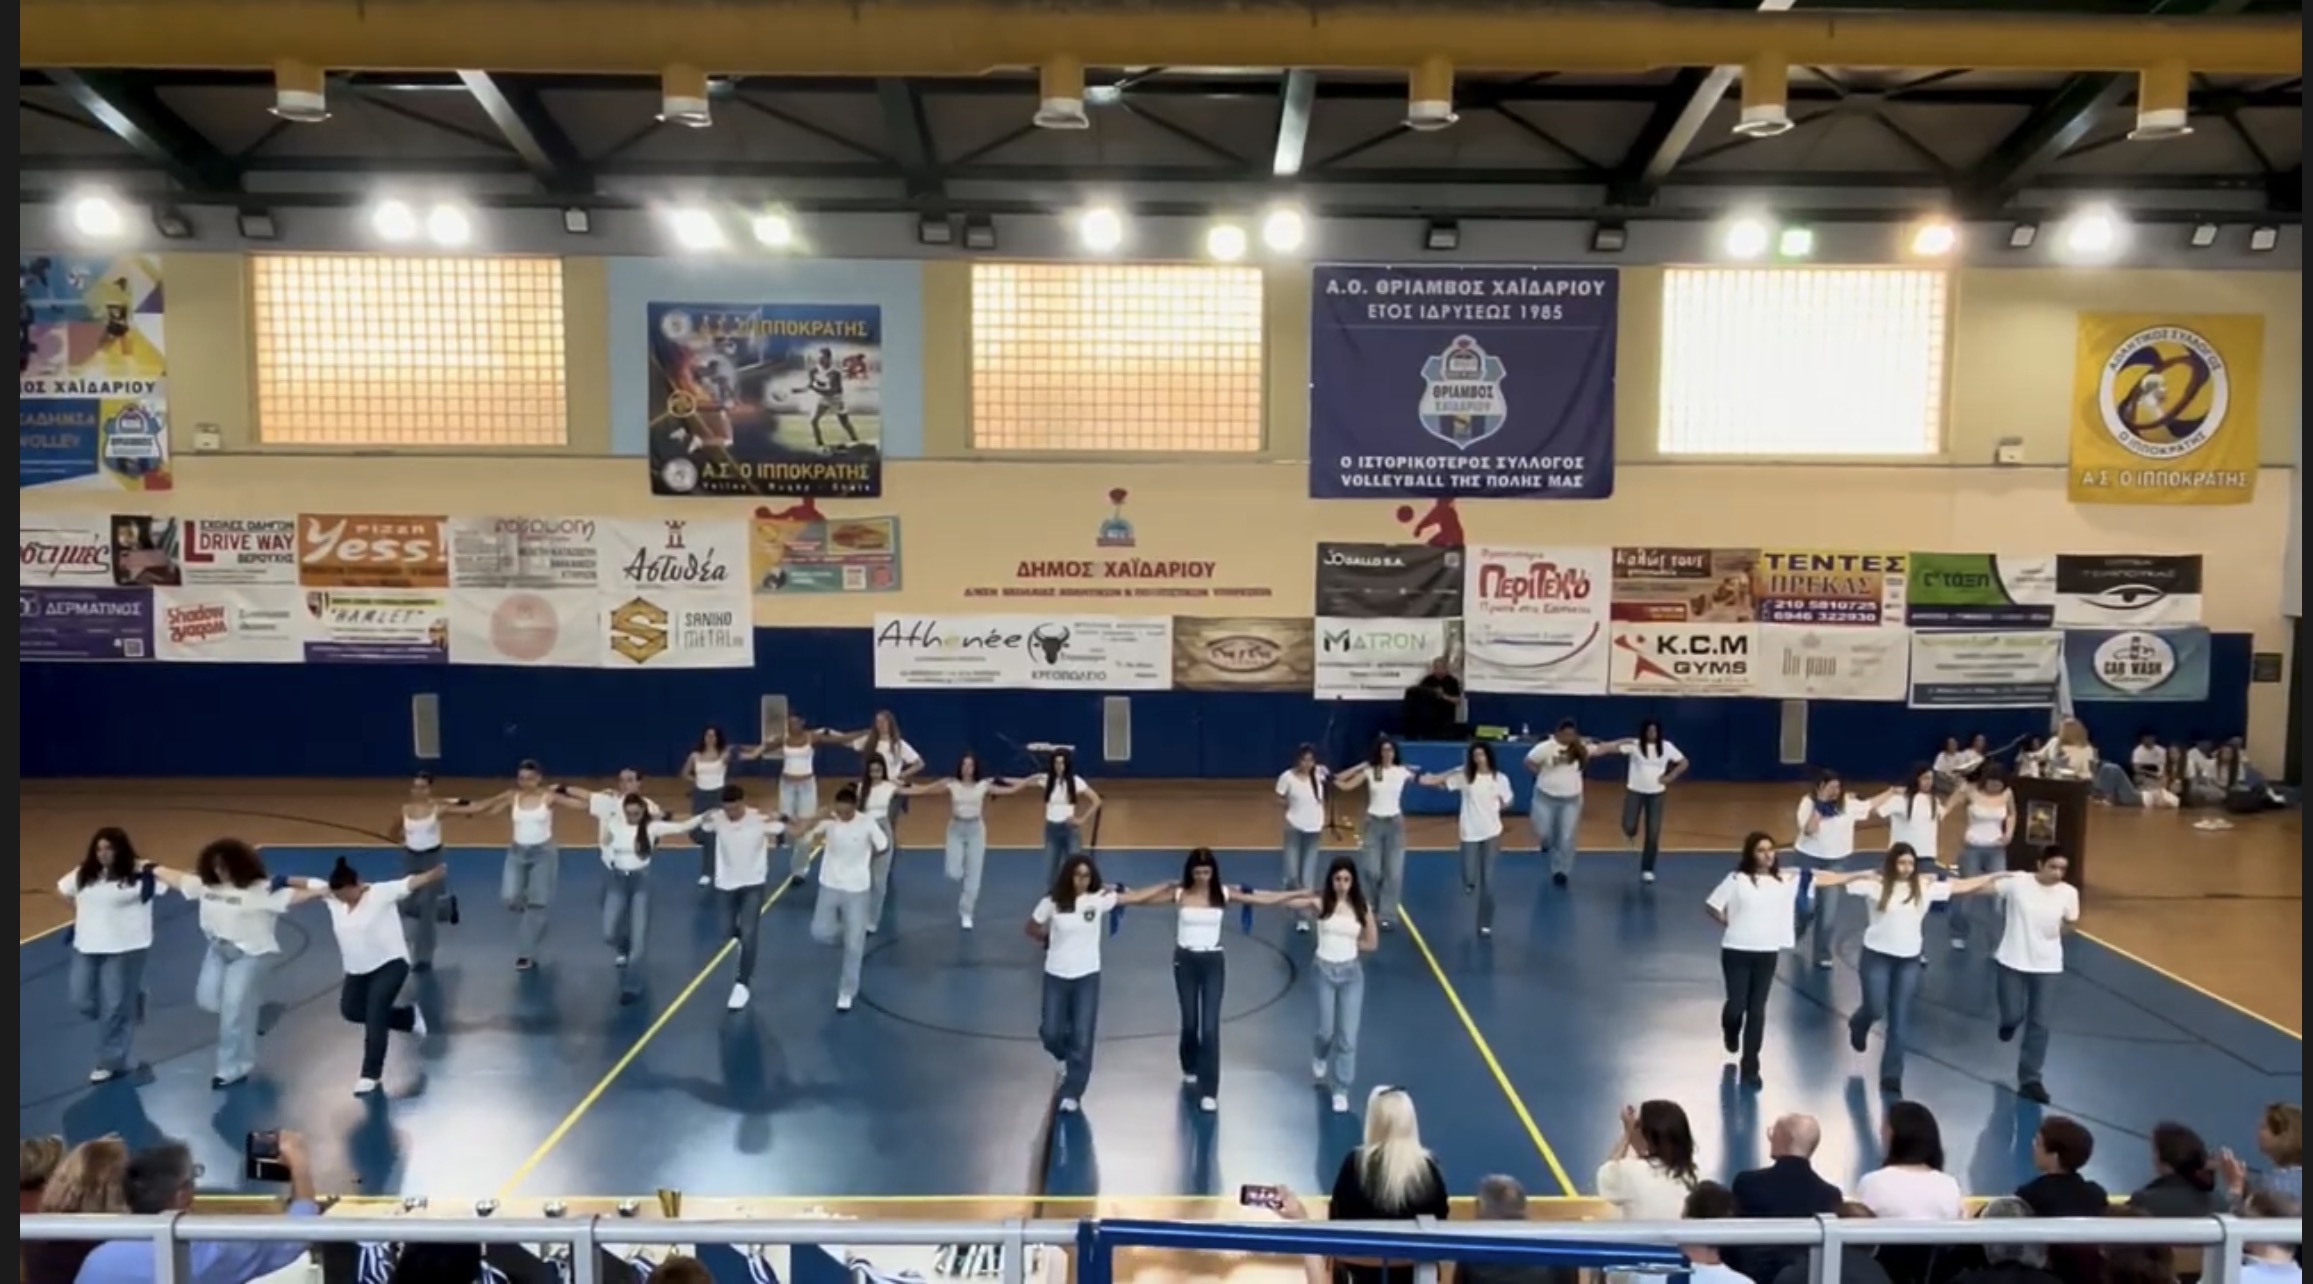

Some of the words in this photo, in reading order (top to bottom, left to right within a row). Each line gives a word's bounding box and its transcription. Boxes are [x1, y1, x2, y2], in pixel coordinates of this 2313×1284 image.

[1376, 280, 1485, 296] ΘΡΙΑΜΒΟΣ
[1491, 278, 1606, 296] ΧΑΪΔΑΡΙΟΥ
[1367, 304, 1413, 319] ΕΤΟΣ
[1420, 304, 1512, 320] ΙΔΡΥΣΕΩΣ
[1520, 304, 1563, 320] 1985
[753, 320, 868, 337] ΙΠΠΟΚΡΑΤΗΣ
[20, 381, 46, 394] ΟΣ
[54, 379, 155, 394] ΧΑΪΔΑΡΙΟΥ
[1433, 384, 1494, 399] ΘΡΙΑΜΒΟΣ
[1341, 456, 1352, 469] Ο
[1358, 456, 1490, 470] ΙΣΤΟΡΙΚΟΤΕΡΟΣ
[1496, 456, 1585, 470] ΣΥΛΛΟΓΟΣ
[757, 464, 870, 481] ΙΠΠΟΚΡΑΤΗΣ
[2137, 471, 2248, 487] ΙΠΠΟΚΡΑΤΗΣ
[1341, 475, 1445, 488] VOLLEYBALL
[1450, 475, 1480, 488] ΤΗΣ
[1485, 475, 1543, 488] ΠΟΛΗΣ
[1548, 475, 1584, 488] ΜΑΣ
[201, 532, 251, 550] DRIVE
[257, 533, 294, 550] WAY
[1016, 561, 1095, 578] ΔΗΜΟΣ
[1104, 557, 1216, 578] ΧΑΪΔΑΡΙΟΥ
[1764, 553, 1906, 573] ΤΕΝΤΕΣ
[1771, 575, 1872, 595] ΠΡΕΚΑΣ
[1774, 600, 1804, 610] 210
[1773, 611, 1813, 621] 6946
[1817, 612, 1877, 622] 322930
[1656, 634, 1748, 655] K.C.M
[1673, 661, 1748, 675] GYMS
[2104, 661, 2126, 675] CAR
[2130, 661, 2163, 675] WASH
